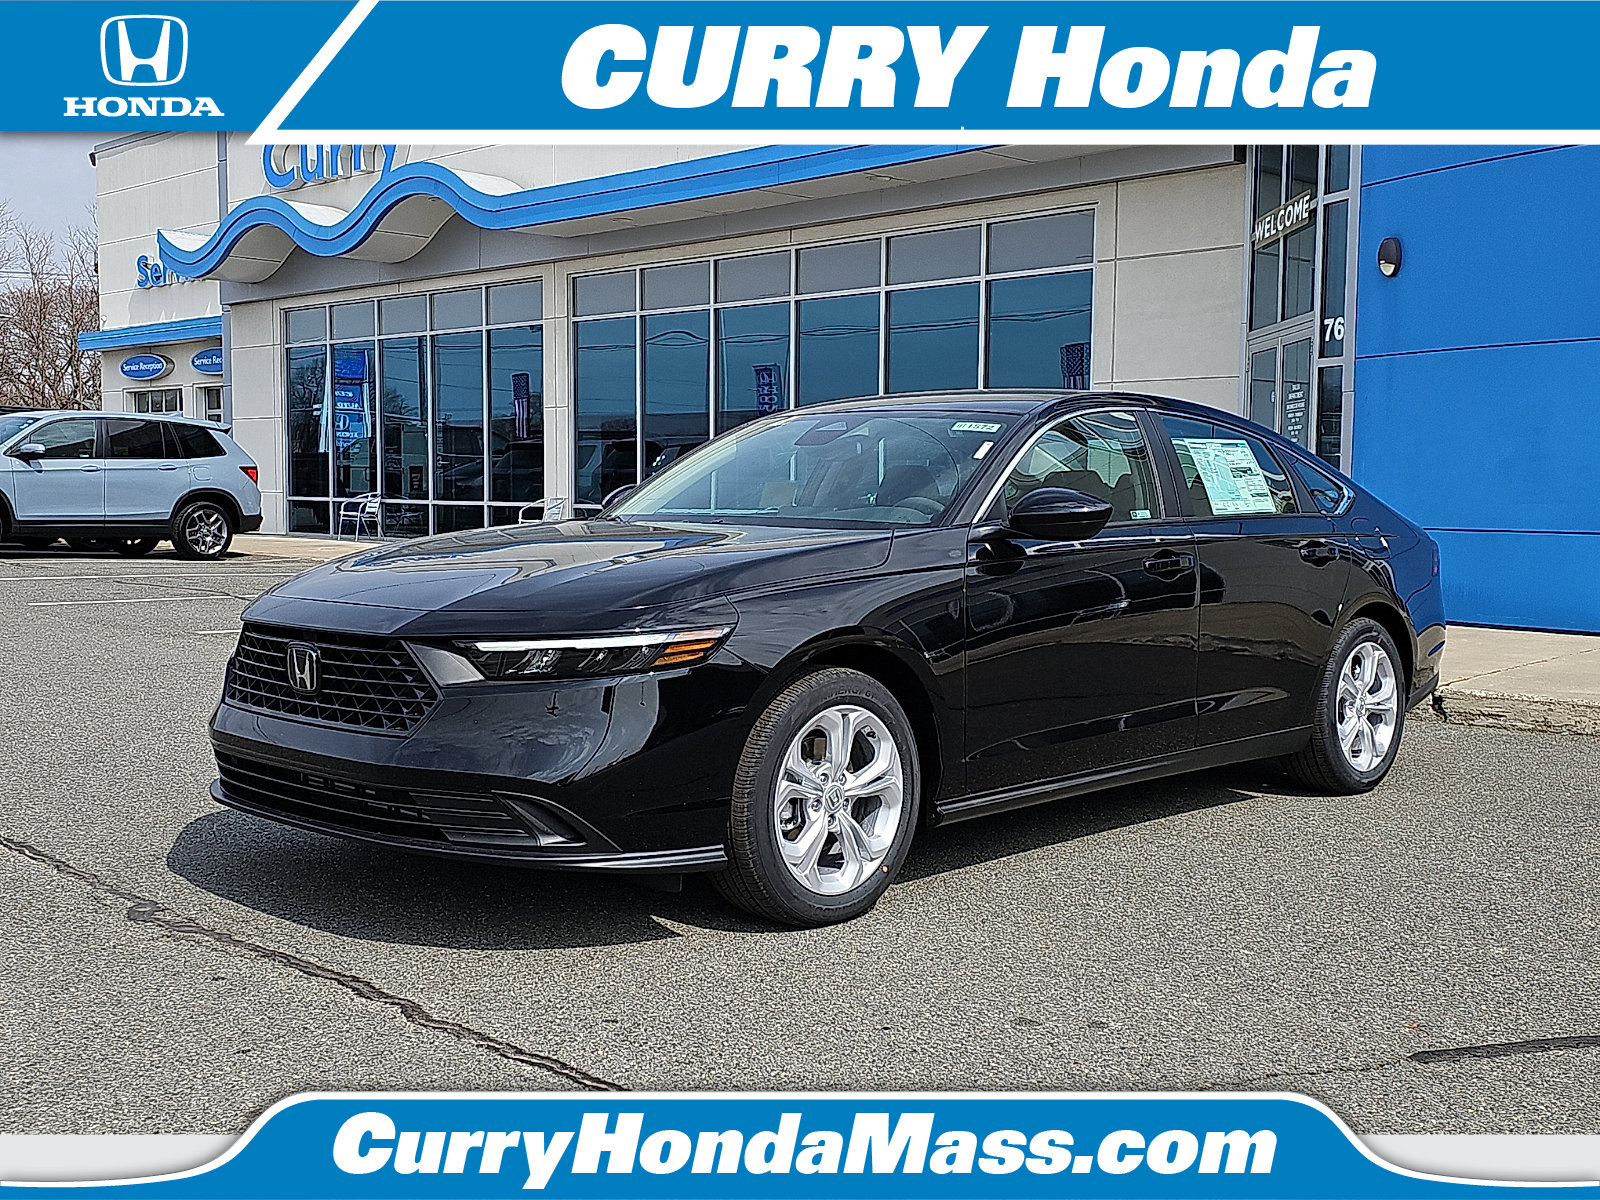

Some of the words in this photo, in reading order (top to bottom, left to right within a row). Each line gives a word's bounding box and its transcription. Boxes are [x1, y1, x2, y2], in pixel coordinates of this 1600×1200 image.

[263, 144, 397, 188] Curry
[1255, 195, 1310, 243] WELCOME
[1324, 316, 1345, 342] 76
[122, 363, 139, 371] Service
[140, 361, 162, 372] Reception
[194, 356, 212, 365] Service
